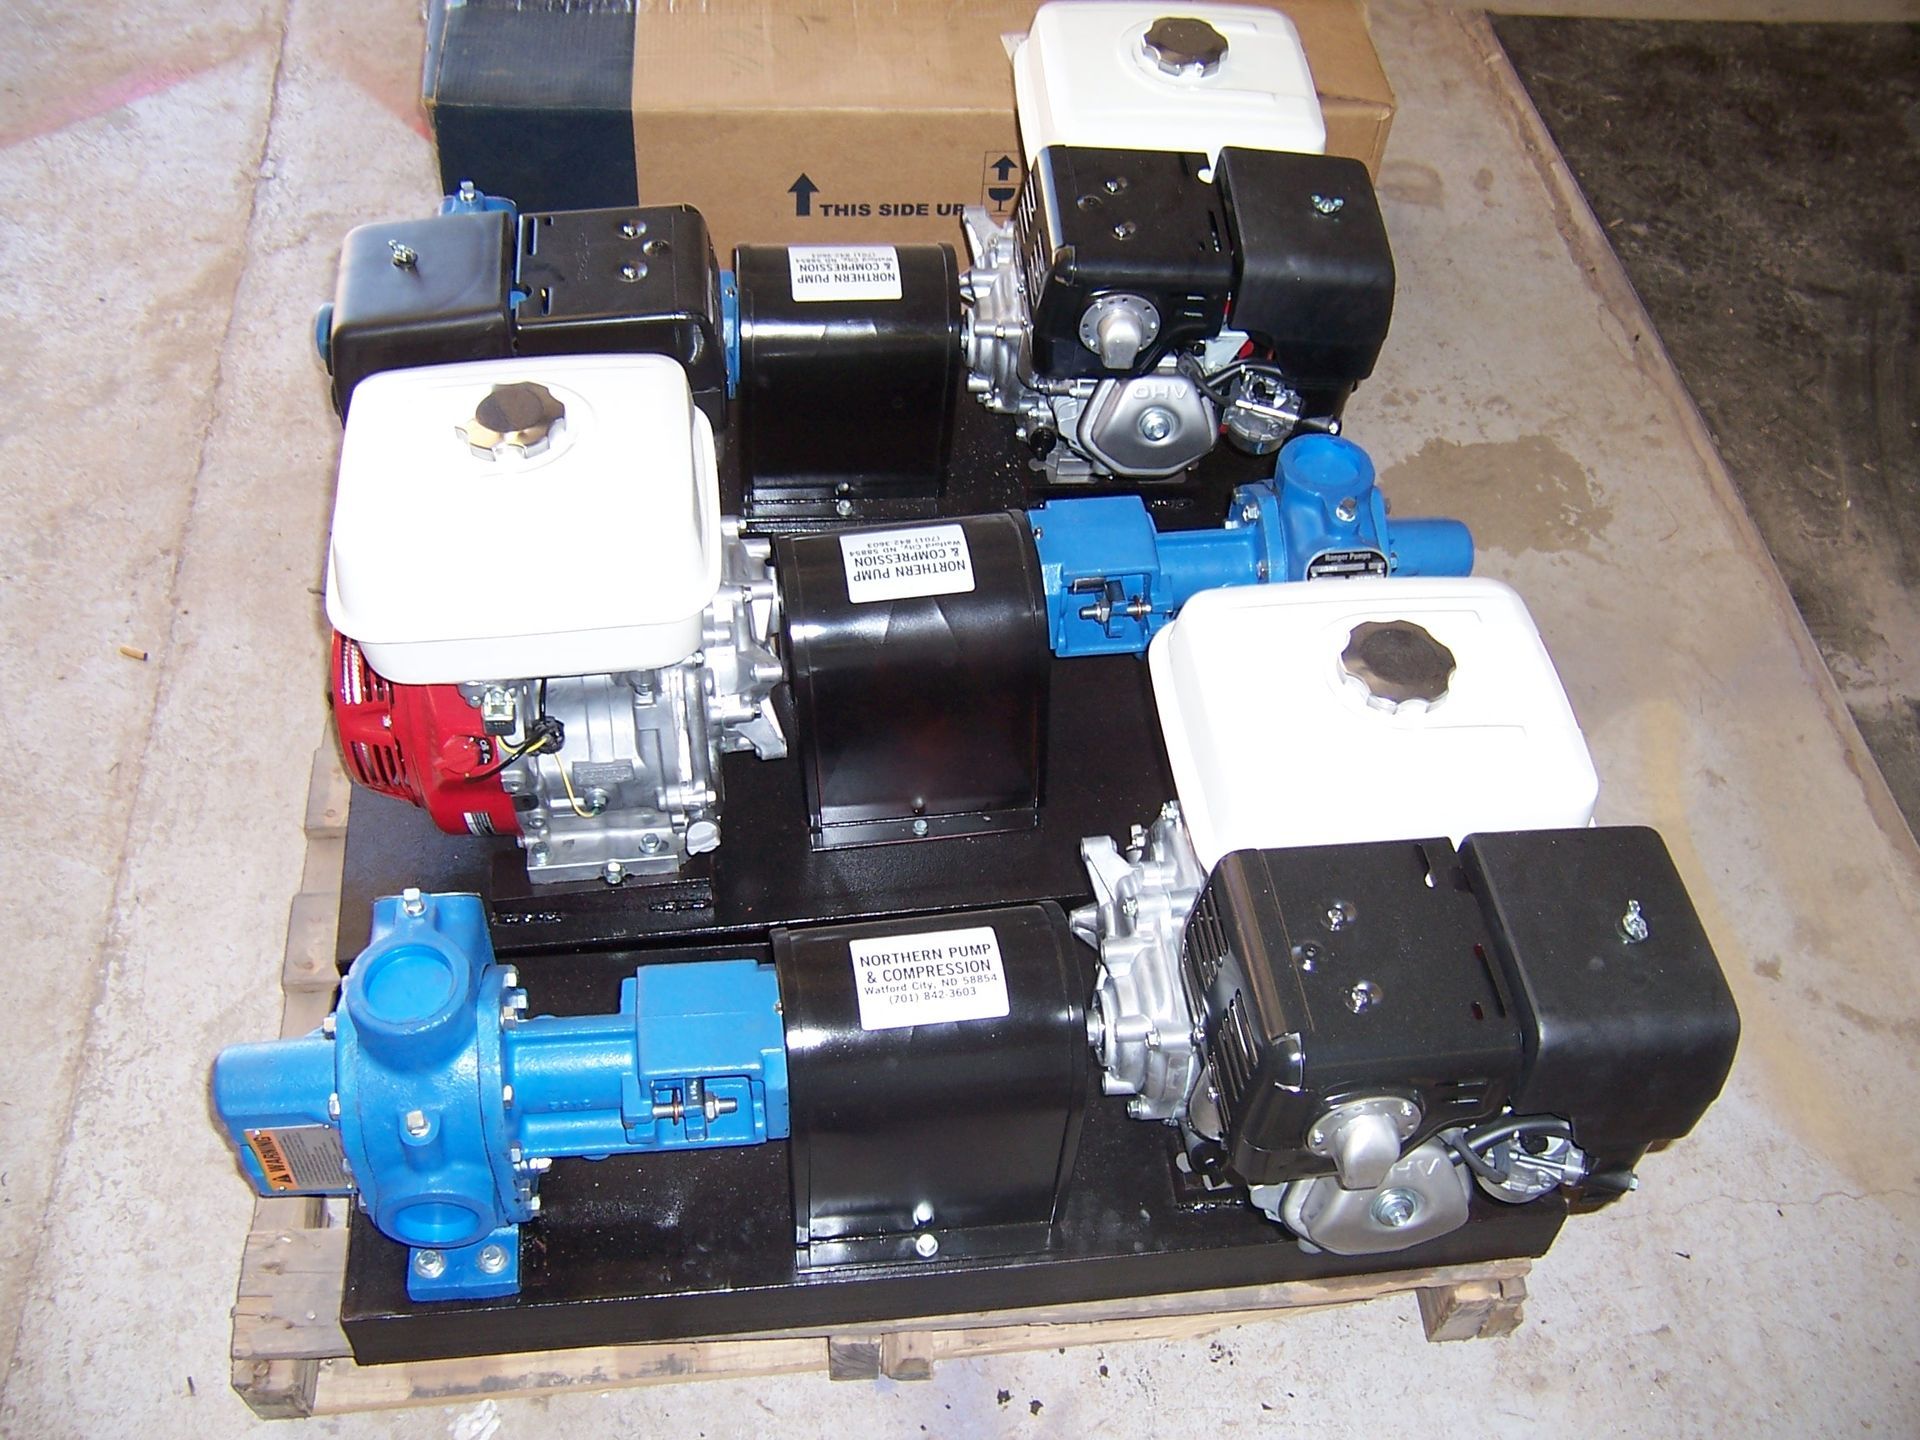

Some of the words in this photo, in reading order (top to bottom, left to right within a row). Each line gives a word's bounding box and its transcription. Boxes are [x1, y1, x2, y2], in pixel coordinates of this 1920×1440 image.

[819, 203, 871, 217] THIS
[878, 203, 929, 216] SIDE
[936, 203, 965, 216] UP
[799, 262, 880, 272] COMPRESSION
[883, 262, 891, 270] &
[797, 274, 829, 284] PUMP
[834, 273, 896, 283] NORTHERN
[1133, 383, 1189, 399] OHV
[854, 549, 946, 568] COMPRESSION
[950, 547, 959, 557] &
[853, 568, 890, 582] PUMP
[896, 560, 966, 577] NORTHERN
[859, 948, 943, 968] NORTHERN
[948, 943, 991, 958] PUMP
[866, 971, 878, 984] &
[882, 959, 991, 982] COMPRESSION
[864, 983, 907, 995] Watford
[911, 980, 937, 991] City,
[941, 978, 958, 987] ND
[963, 973, 998, 985] 58854
[889, 992, 919, 1005] (701)
[253, 1136, 287, 1173] WARNING
